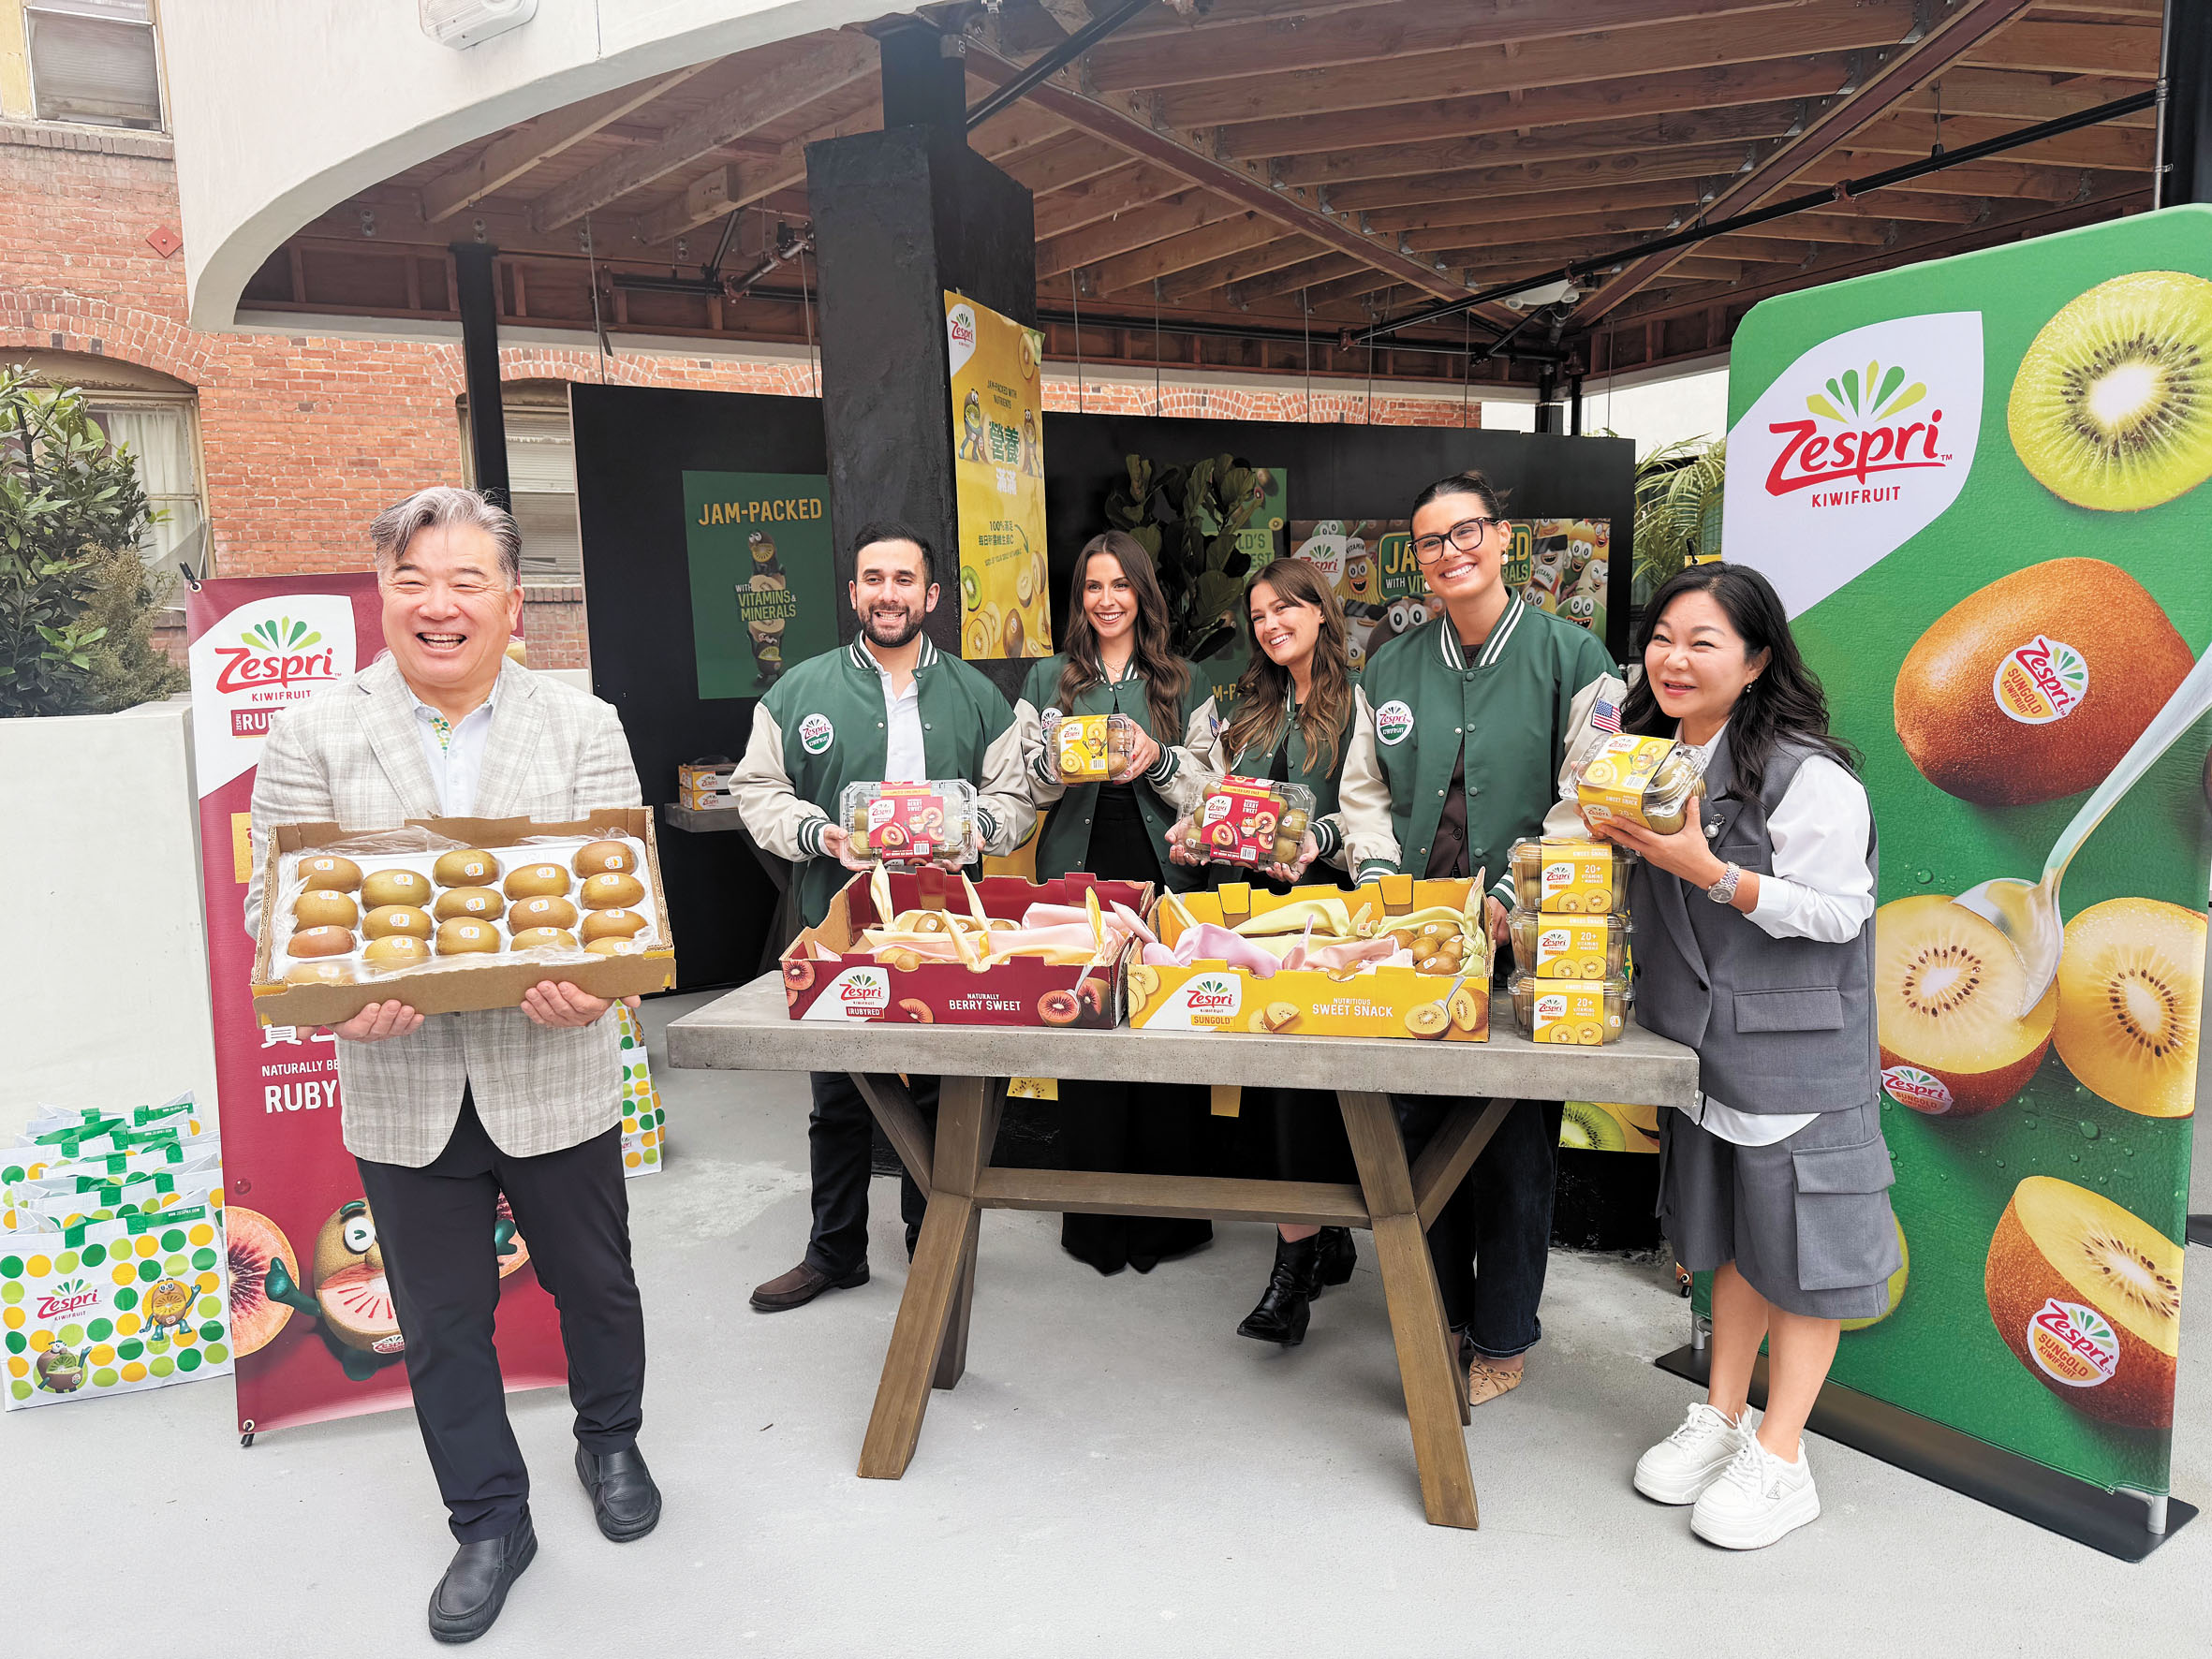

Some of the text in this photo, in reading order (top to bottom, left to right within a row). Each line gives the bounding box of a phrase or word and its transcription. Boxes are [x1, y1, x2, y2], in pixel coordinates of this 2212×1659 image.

[951, 320, 974, 343] Zespri
[1765, 408, 1945, 496] Zespri
[1811, 486, 1901, 507] KIWIFRUIT
[699, 498, 822, 526] JAM-PACKED
[1238, 533, 1265, 550] LD'S
[1250, 552, 1272, 568] EST
[1386, 577, 1406, 589] WITH
[738, 590, 790, 607] VITAMINS
[741, 604, 796, 622] MINERALS
[214, 647, 338, 694] Zespri
[2016, 639, 2075, 712] Zespri
[252, 689, 311, 702] KIWIFRUIT
[2002, 680, 2029, 713] KIWIFRUIT
[2008, 668, 2042, 714] SUNGOLD
[1379, 713, 1408, 727] Zespri
[803, 723, 828, 740] Zespri
[1546, 864, 1601, 881] Zespri 20+
[1542, 932, 1597, 947] Zespri 20+
[839, 983, 883, 1001] Zespri
[1187, 990, 1234, 1008] Zespri
[949, 999, 1021, 1011] BERRY SWEET
[1333, 997, 1371, 1006] NUTRITIOUS
[1539, 998, 1593, 1012] Zespri 20+
[1312, 1004, 1394, 1018] SWEET SNACK
[1194, 1016, 1231, 1025] SUNGOLD
[261, 1059, 339, 1077] NATURALLY BE
[1882, 1072, 1945, 1102] Zespri
[1895, 1092, 1938, 1108] SUNGOLD
[37, 1289, 100, 1319] Zespri
[54, 1311, 86, 1321] KIWIFRUIT
[2037, 1301, 2114, 1372] Zespri
[2038, 1345, 2076, 1378] KIWIFRUIT
[2039, 1333, 2088, 1377] SUNGOLD
